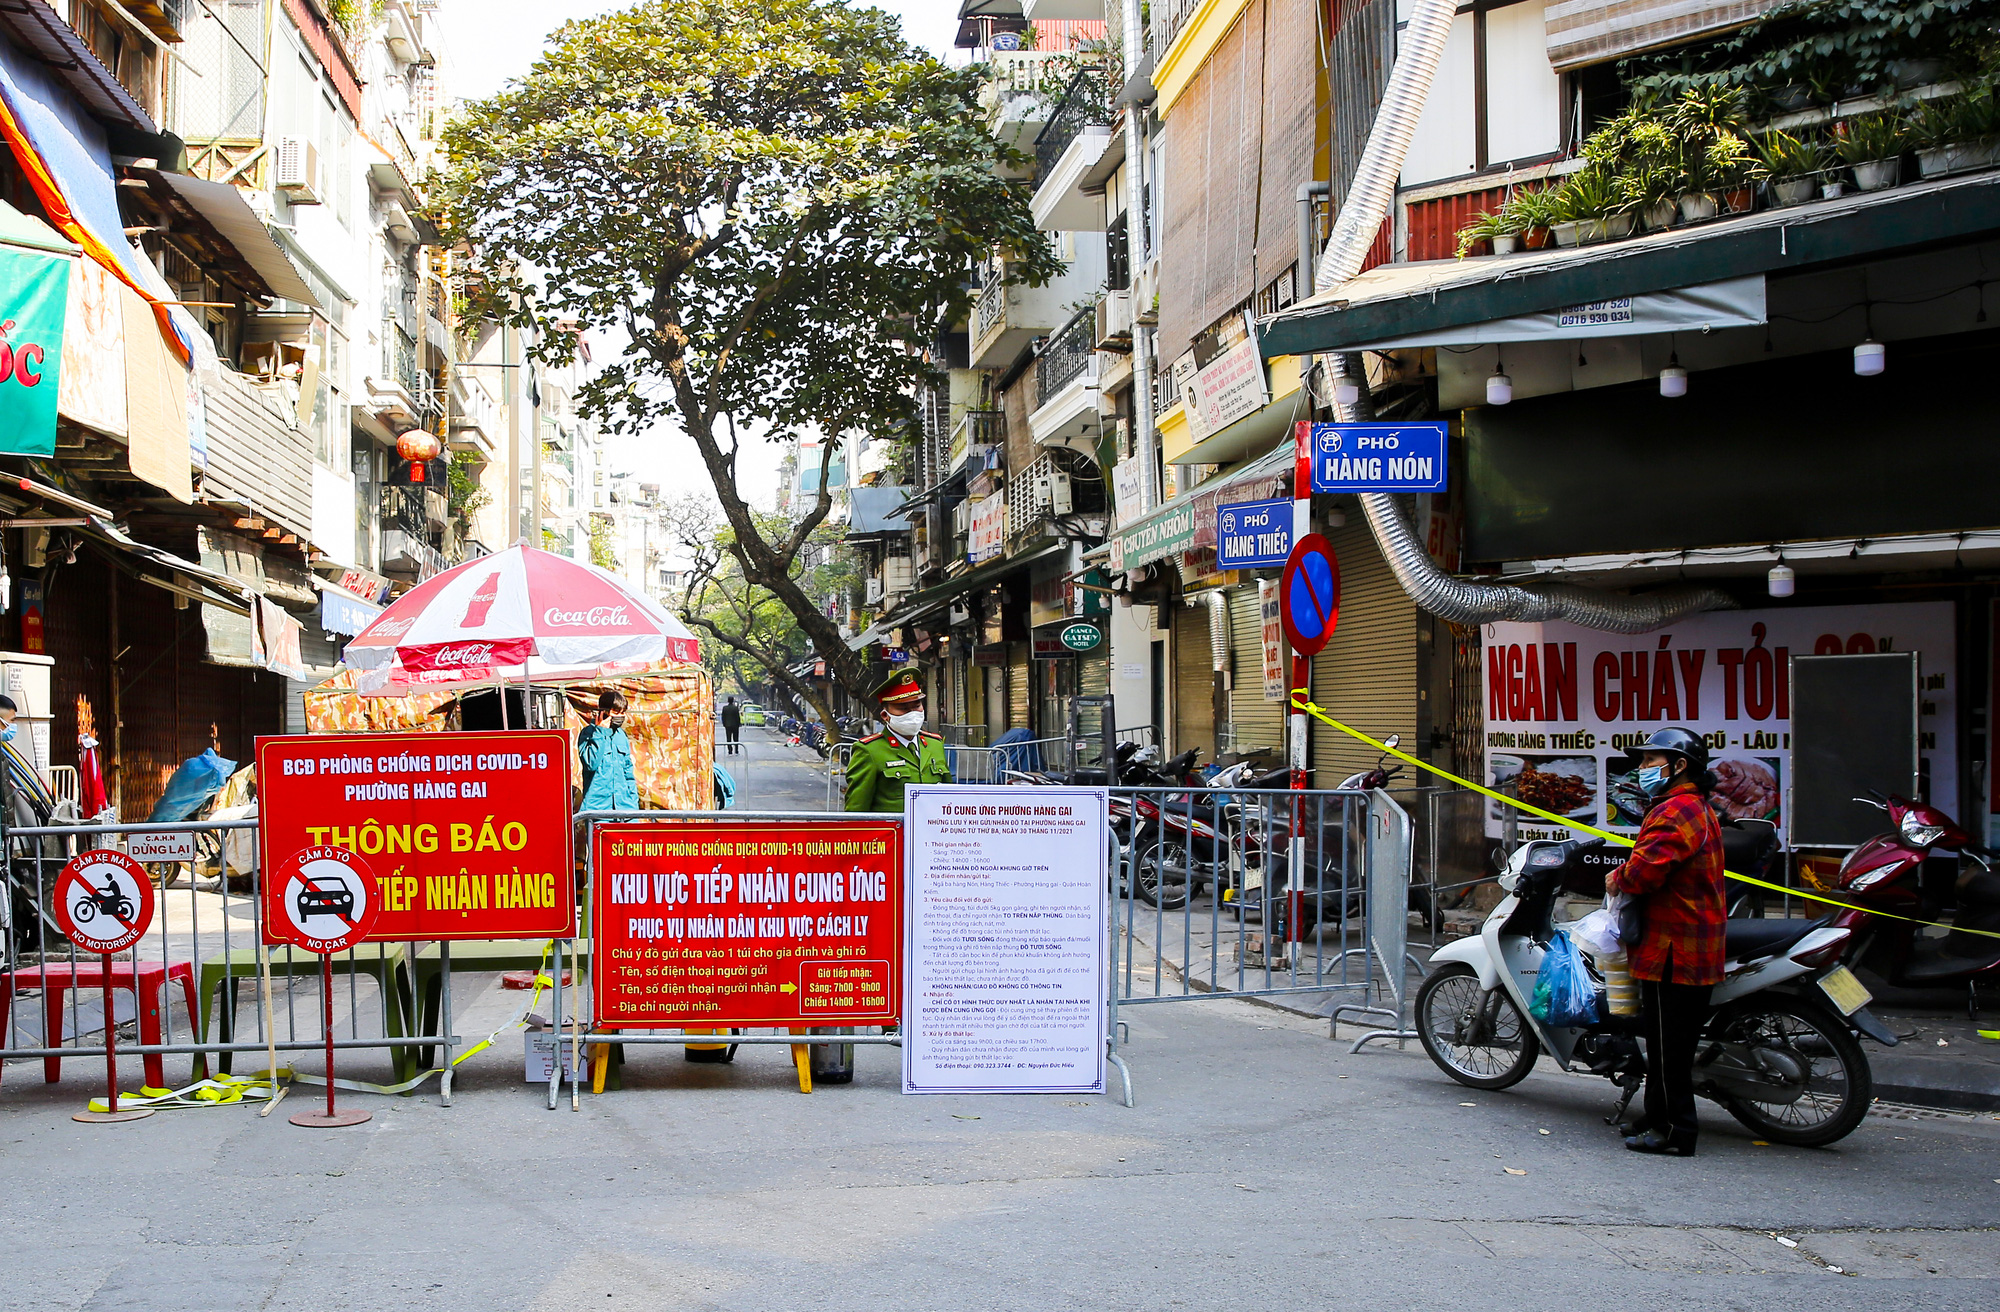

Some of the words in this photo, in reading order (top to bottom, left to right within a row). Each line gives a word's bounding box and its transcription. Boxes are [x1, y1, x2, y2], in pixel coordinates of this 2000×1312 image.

[1610, 298, 1630, 309] 520
[1561, 314, 1587, 325] 0916
[1589, 313, 1608, 323] 930
[1610, 311, 1630, 321] 034
[1357, 431, 1400, 450] PHỐ
[1325, 452, 1382, 481] HÀNG
[1388, 451, 1433, 480] NÓN
[1244, 508, 1270, 527] PHỐ
[1123, 522, 1158, 555] CHUYÊN
[1159, 510, 1189, 541] NHÔM
[1225, 531, 1255, 558] HÀNG
[1257, 525, 1288, 556] THIẾC
[544, 604, 632, 627] Coca-Cola
[367, 616, 416, 637] Coca-Cola
[434, 643, 495, 666] Coca-Cola
[1488, 642, 1578, 722] NGAN
[1592, 634, 1706, 722] CHÁY
[1717, 621, 1790, 721] TỎI
[1487, 731, 1516, 749] HƯƠNG
[1517, 730, 1546, 749] HÀNG
[1549, 729, 1596, 750] THIẾC
[283, 759, 315, 776] BCĐ
[320, 754, 372, 774] PHÒNG
[377, 751, 431, 772] CHỐNG
[436, 754, 473, 775] DỊCH
[477, 753, 548, 770] COVID-19
[345, 780, 409, 801] PHƯỜNG
[413, 780, 456, 799] HÀNG
[461, 781, 487, 798] GAI
[942, 802, 952, 815] TỔ
[954, 806, 977, 815] CUNG
[979, 804, 996, 815] ỨNG
[998, 804, 1032, 815] PHƯỜNG
[1034, 805, 1056, 815] HÀNG
[1059, 806, 1072, 815] GAI
[306, 818, 439, 854] THÔNG
[450, 815, 528, 852] BÁO
[132, 843, 166, 855] DỪNG
[169, 844, 190, 856] LẠI
[611, 839, 624, 857] SỞ
[627, 839, 643, 857] CHỈ
[645, 843, 664, 857] HUY
[666, 840, 699, 857] PHÒNG
[701, 838, 734, 856] CHỐNG
[736, 842, 758, 859] DỊCH
[761, 842, 803, 855] COVID-19
[806, 839, 831, 858] QUẬN
[834, 839, 860, 855] HOÀN
[862, 837, 886, 854] KIẾM
[95, 853, 108, 863] XE
[110, 854, 133, 869] MÁY
[1583, 855, 1600, 865] Có
[1603, 855, 1626, 865] bán
[376, 865, 418, 911] TIẾP
[426, 868, 487, 918] NHẬN
[495, 866, 555, 909] HÀNG
[611, 873, 648, 904] KHU
[653, 870, 689, 911] VỰC
[693, 863, 733, 904] TIẾP
[738, 866, 789, 910] NHẬN
[794, 871, 844, 903] CUNG
[849, 865, 886, 902] ỨNG
[628, 918, 664, 943] PHỤC
[667, 918, 684, 943] VỤ
[687, 913, 724, 938] NHÂN
[728, 913, 755, 938] DÂN
[758, 917, 785, 938] KHU
[788, 915, 813, 942] VỰC
[817, 912, 851, 937] CÁCH
[854, 915, 869, 936] LY
[71, 930, 86, 943] NO
[86, 928, 140, 950] MOTORBIKE
[306, 938, 322, 950] NO
[324, 937, 348, 950] CAR
[612, 948, 633, 959] Chú
[636, 948, 642, 961] ý
[645, 947, 659, 958] đồ
[661, 947, 679, 961] gửi
[682, 948, 703, 958] đưa
[705, 948, 725, 958] vào
[727, 948, 733, 958] 1
[737, 948, 751, 958] túi
[754, 947, 773, 958] cho
[776, 947, 792, 960] gia
[795, 946, 818, 957] đình
[821, 946, 834, 956] và
[836, 945, 853, 958] ghi
[856, 945, 867, 956] rõ
[619, 965, 643, 978] Tên,
[645, 965, 659, 976] số
[661, 965, 685, 978] điện
[687, 966, 715, 978] thoại
[717, 965, 748, 978] người
[751, 964, 768, 977] gửi
[817, 968, 831, 979] Giờ
[832, 967, 848, 979] tiếp
[850, 967, 873, 980] nhận:
[619, 983, 643, 995] Tên,
[645, 983, 659, 994] số
[661, 983, 685, 996] điện
[687, 983, 715, 996] thoại
[717, 983, 748, 996] người
[750, 982, 777, 994] nhận
[809, 982, 832, 994] Sáng:
[834, 982, 854, 992] 7h00
[860, 982, 881, 992] 9h00
[619, 1001, 637, 1013] Địa
[640, 1001, 656, 1012] chỉ
[659, 1001, 689, 1013] người
[692, 1001, 721, 1013] nhận.
[829, 996, 854, 1006] 14h00
[861, 996, 885, 1006] 16h00
